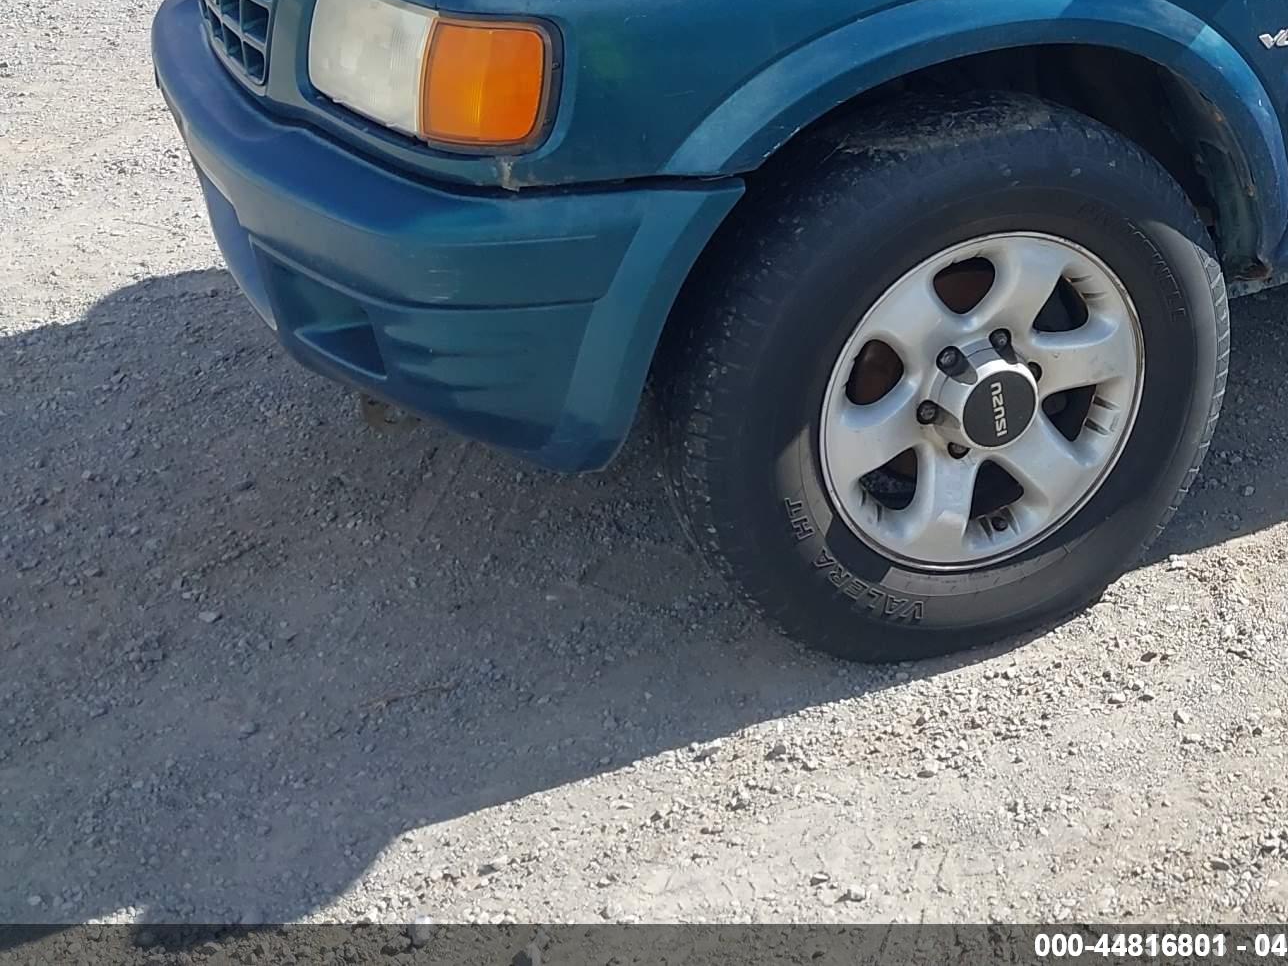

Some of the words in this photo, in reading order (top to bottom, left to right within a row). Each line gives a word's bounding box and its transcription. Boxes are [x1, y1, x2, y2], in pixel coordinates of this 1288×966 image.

[990, 381, 1008, 437] ISUZU
[784, 497, 816, 541] HT
[813, 545, 925, 620] VALERA
